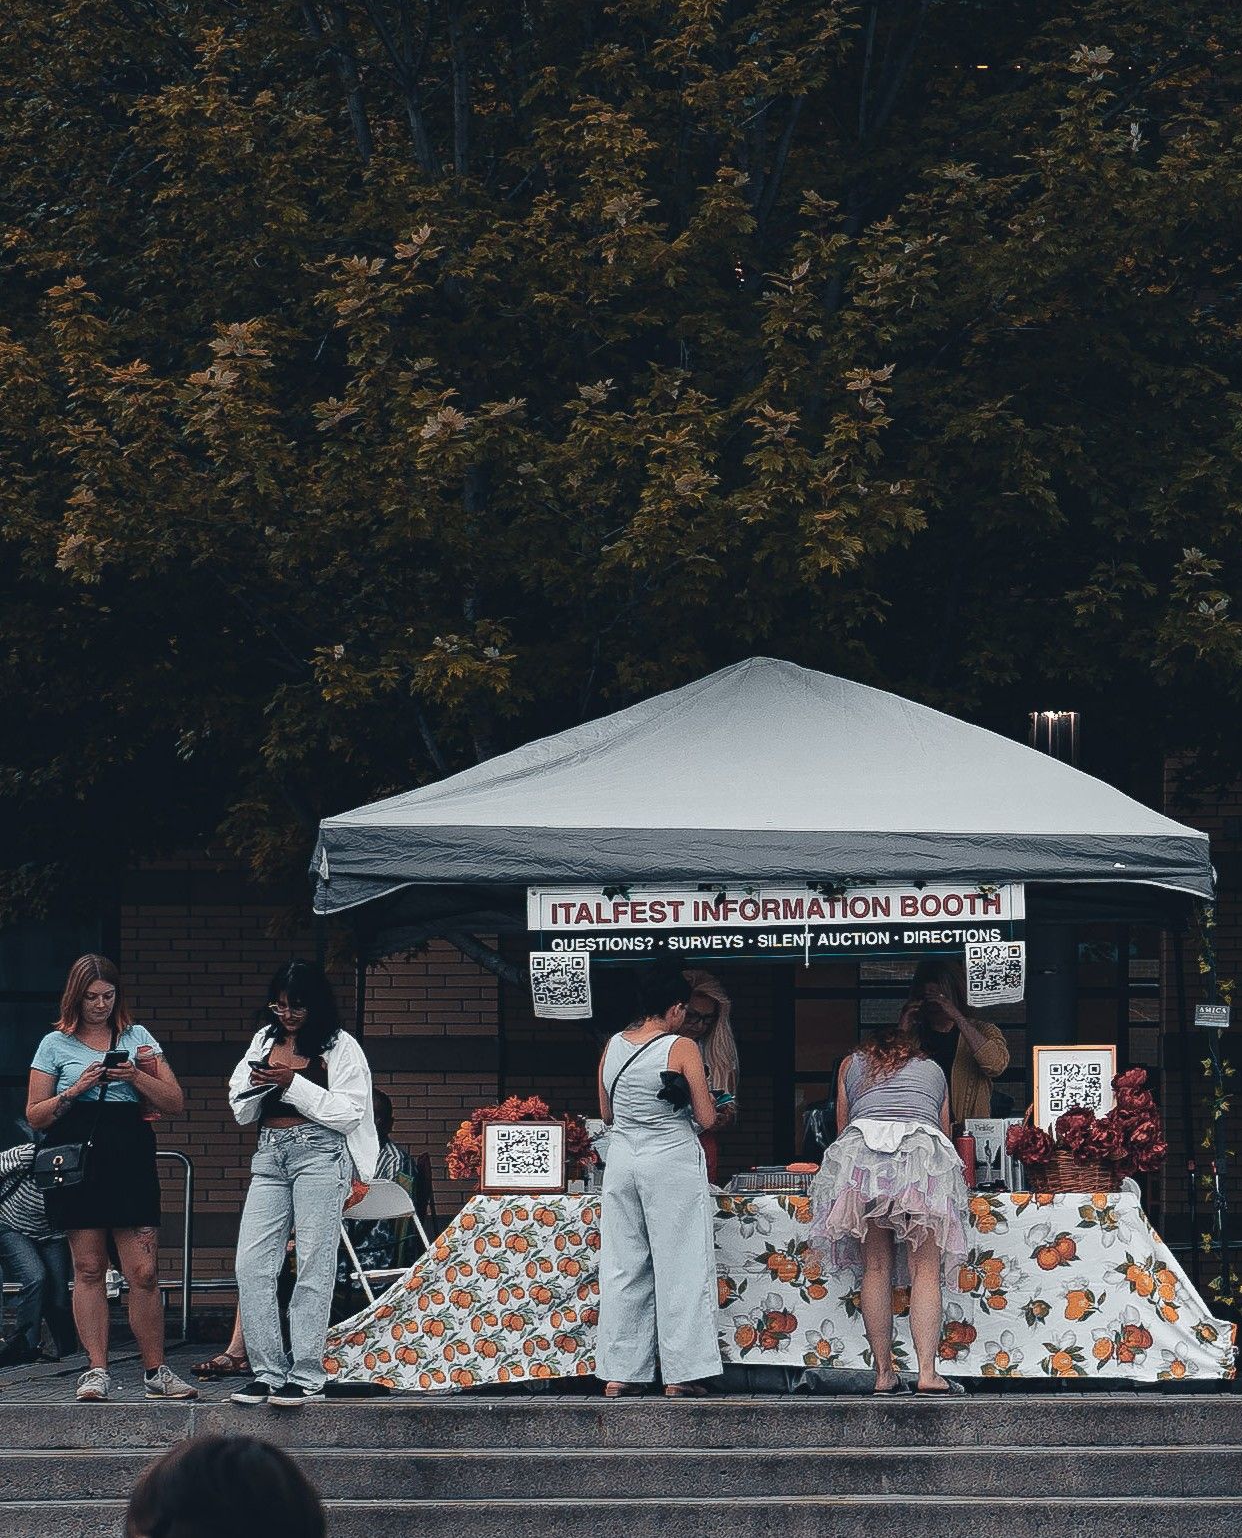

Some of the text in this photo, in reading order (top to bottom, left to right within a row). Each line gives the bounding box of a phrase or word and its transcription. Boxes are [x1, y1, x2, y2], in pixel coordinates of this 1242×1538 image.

[551, 892, 1002, 925] ITALFEST INFORMATION BOOTH
[551, 928, 1001, 953] QUESTIONS? SURVEYS SILENT AUCTION DIRECTIONS
